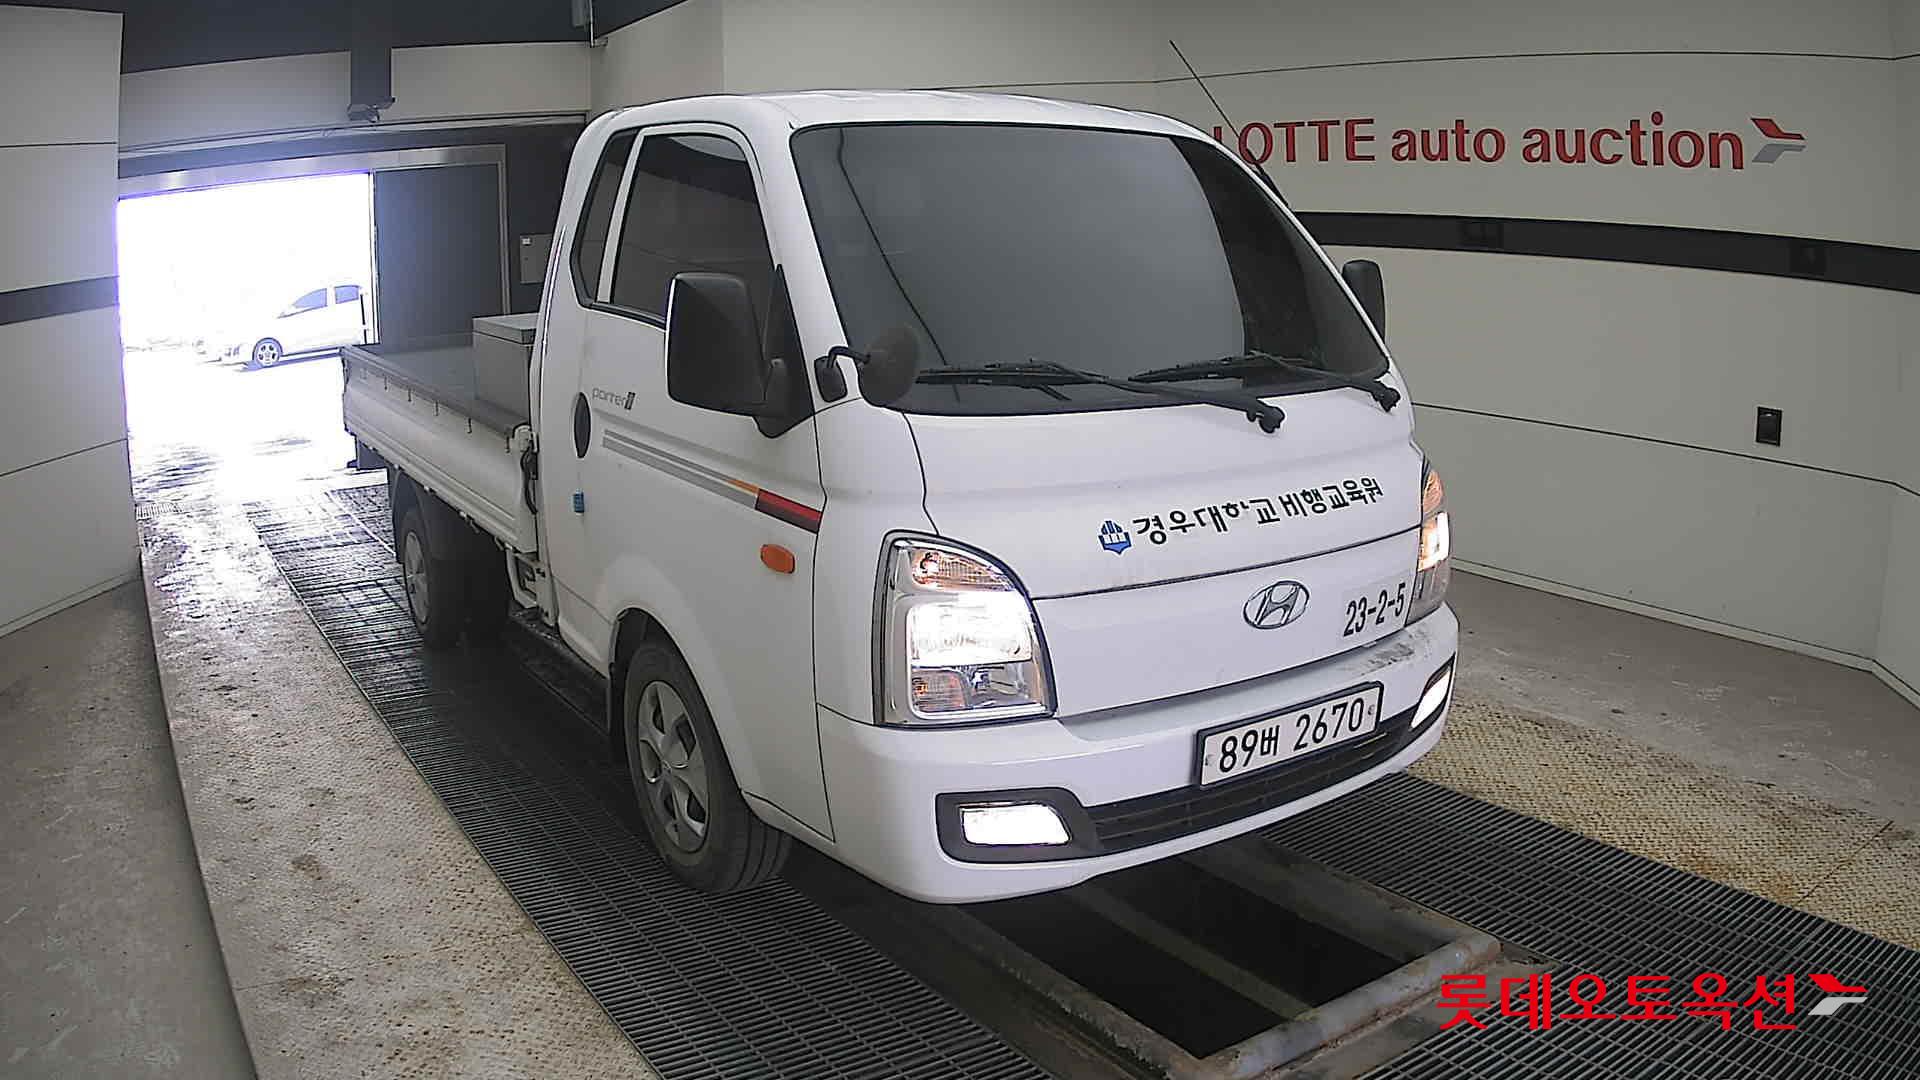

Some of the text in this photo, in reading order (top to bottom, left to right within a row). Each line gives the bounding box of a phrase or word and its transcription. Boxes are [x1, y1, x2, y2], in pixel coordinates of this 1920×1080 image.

[1215, 112, 1743, 171] OTTE auto auction
[1342, 581, 1408, 638] 23-2-5
[1218, 697, 1364, 773] 89버 2670
